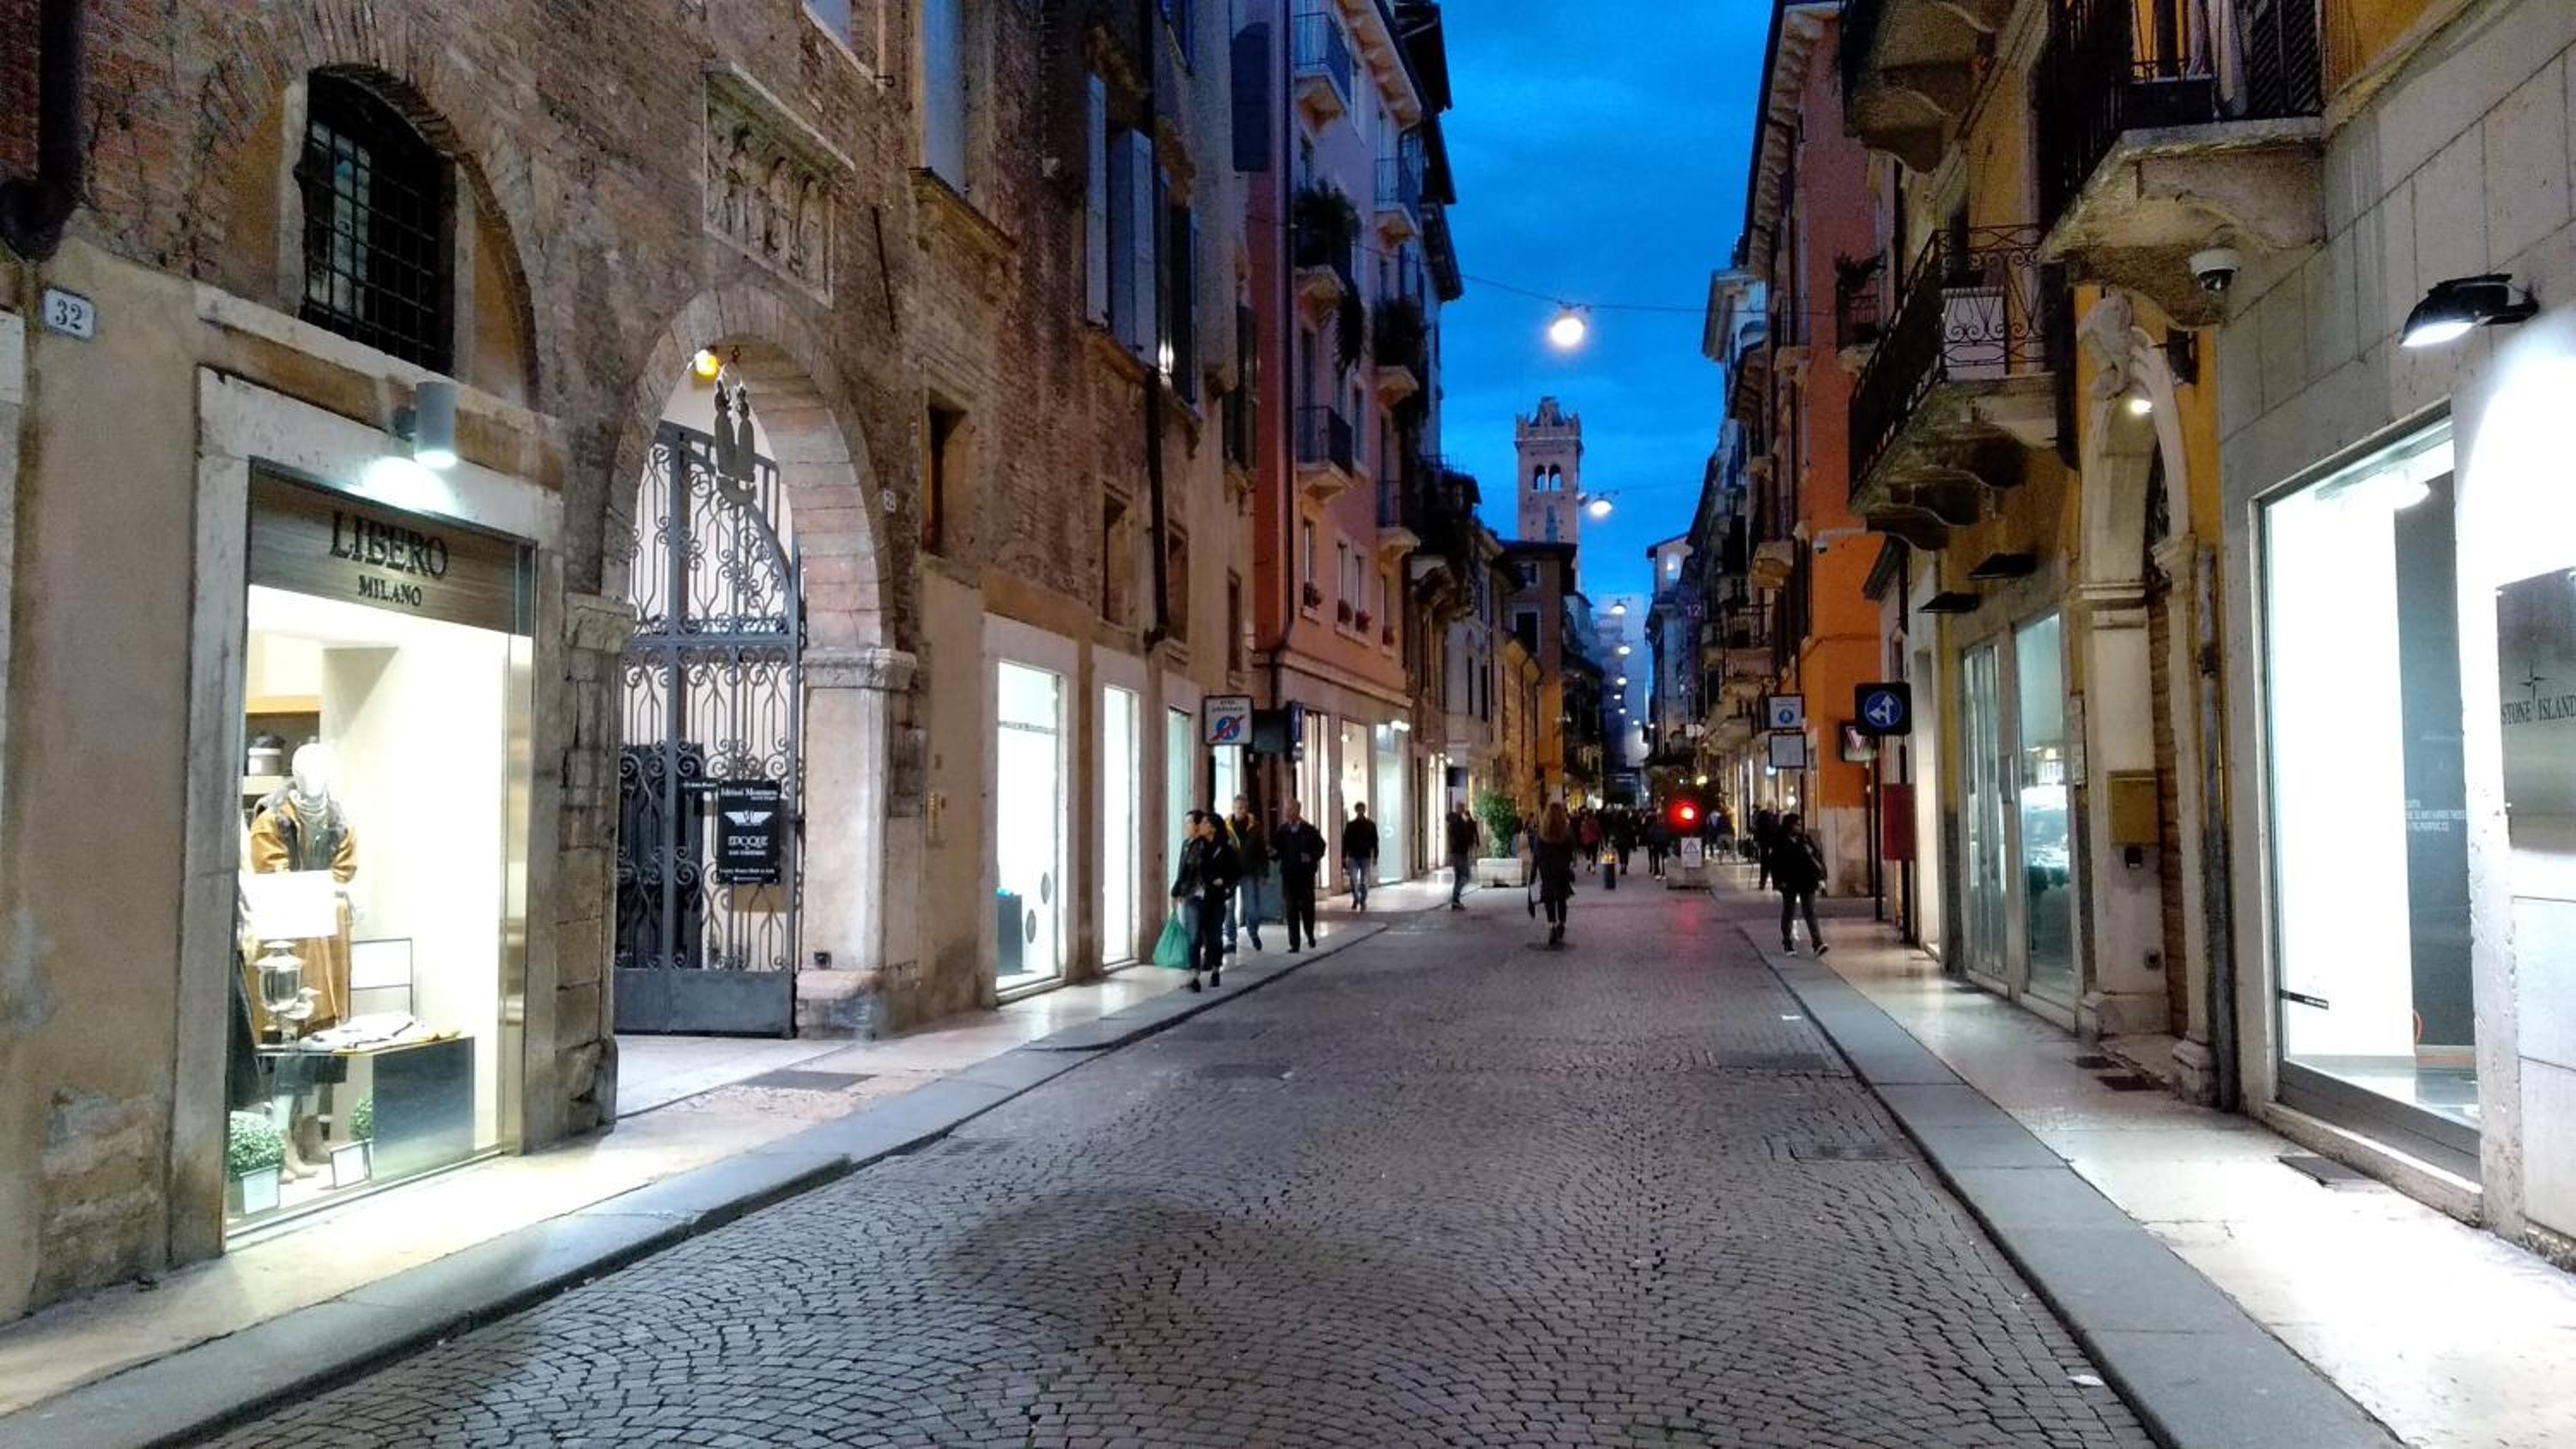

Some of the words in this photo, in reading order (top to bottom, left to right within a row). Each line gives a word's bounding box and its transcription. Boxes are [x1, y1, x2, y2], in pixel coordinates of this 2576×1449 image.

[56, 300, 83, 330] 32
[330, 512, 449, 579] LIBERO
[358, 575, 422, 606] MILANO
[2500, 701, 2531, 724] STONE
